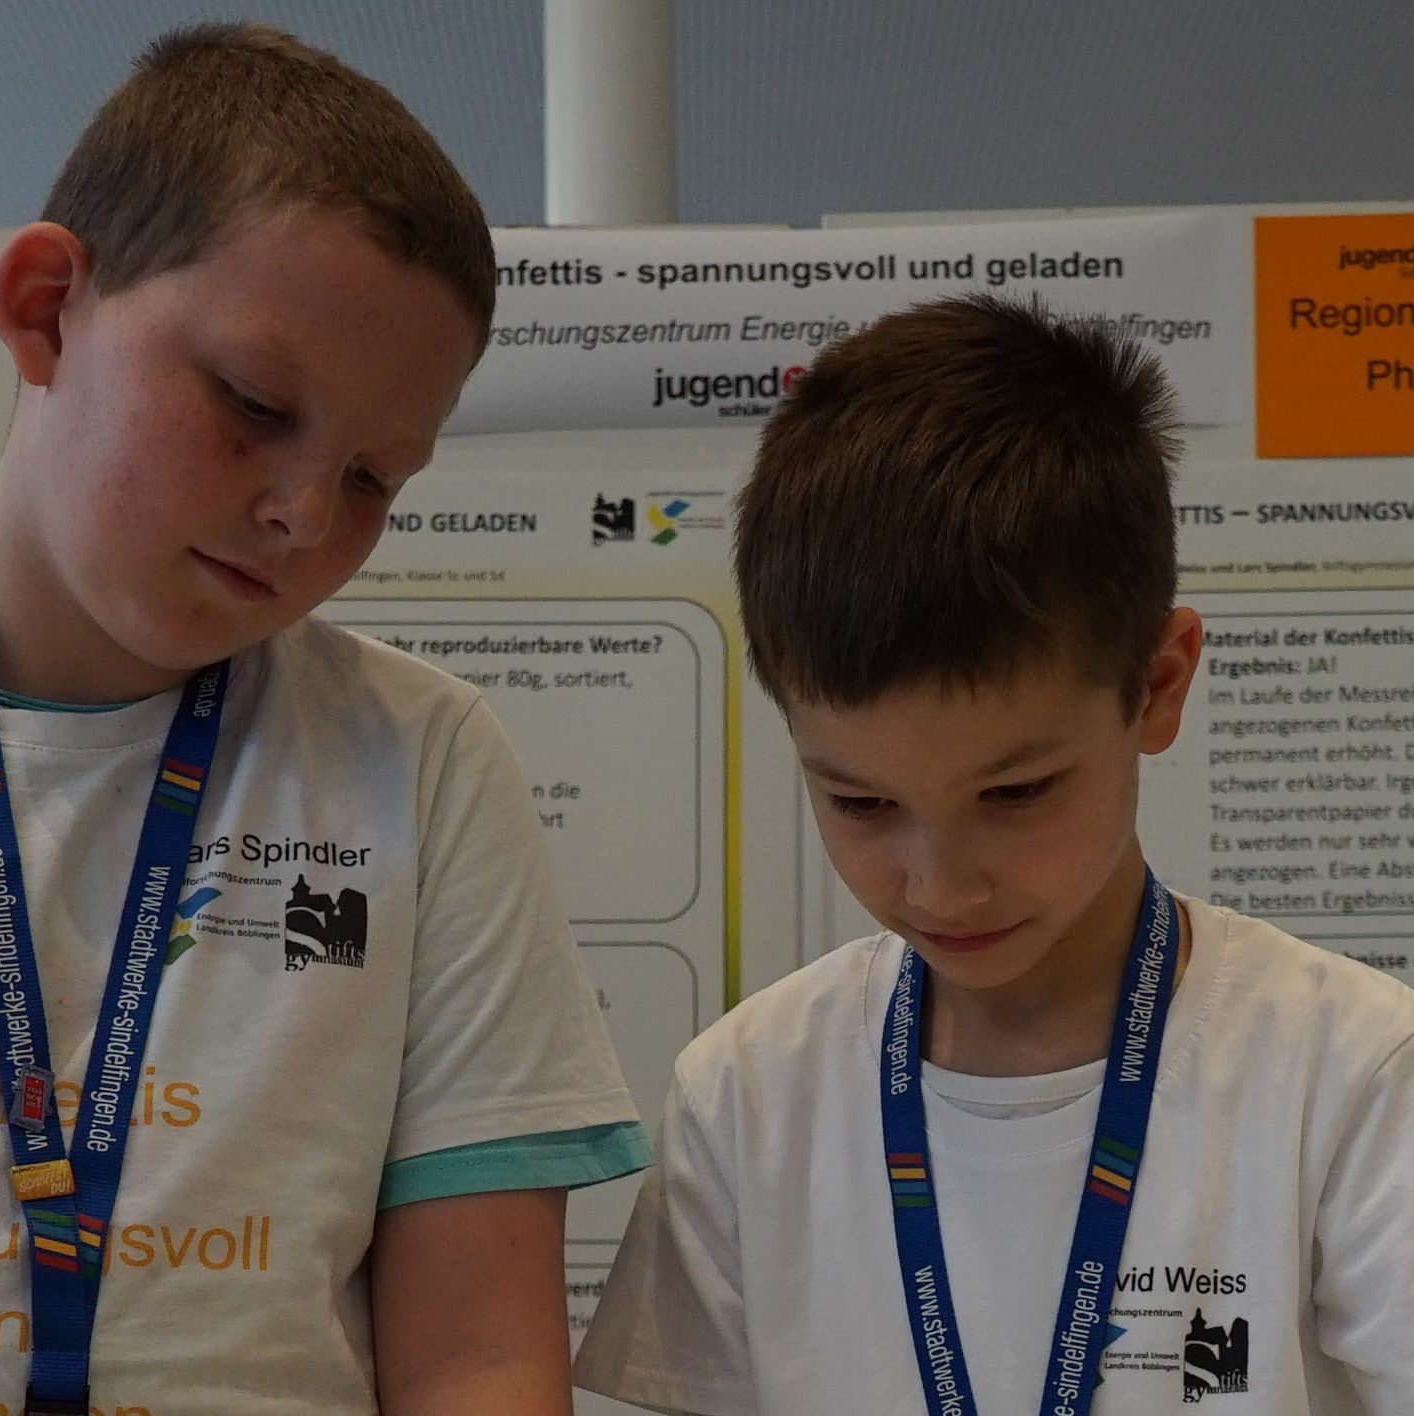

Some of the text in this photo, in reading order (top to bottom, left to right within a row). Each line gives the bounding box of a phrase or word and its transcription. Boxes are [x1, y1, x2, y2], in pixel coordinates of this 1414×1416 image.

[496, 258, 603, 288] nfettis
[637, 254, 896, 290] spannungsvoll
[909, 253, 974, 281] und
[987, 251, 1124, 286] geladen
[487, 314, 850, 351] rschungszentrum Energie
[653, 365, 780, 407] jugend
[389, 513, 537, 532] ND GELADEN
[589, 635, 663, 654] Werte?
[1286, 629, 1317, 646] der
[1324, 627, 1414, 646] Konfettis
[188, 834, 371, 868] ars Spindler
[88, 866, 172, 1153] www.stadtwerke-sindelfingen.de
[1116, 1266, 1247, 1294] vid Weiss
